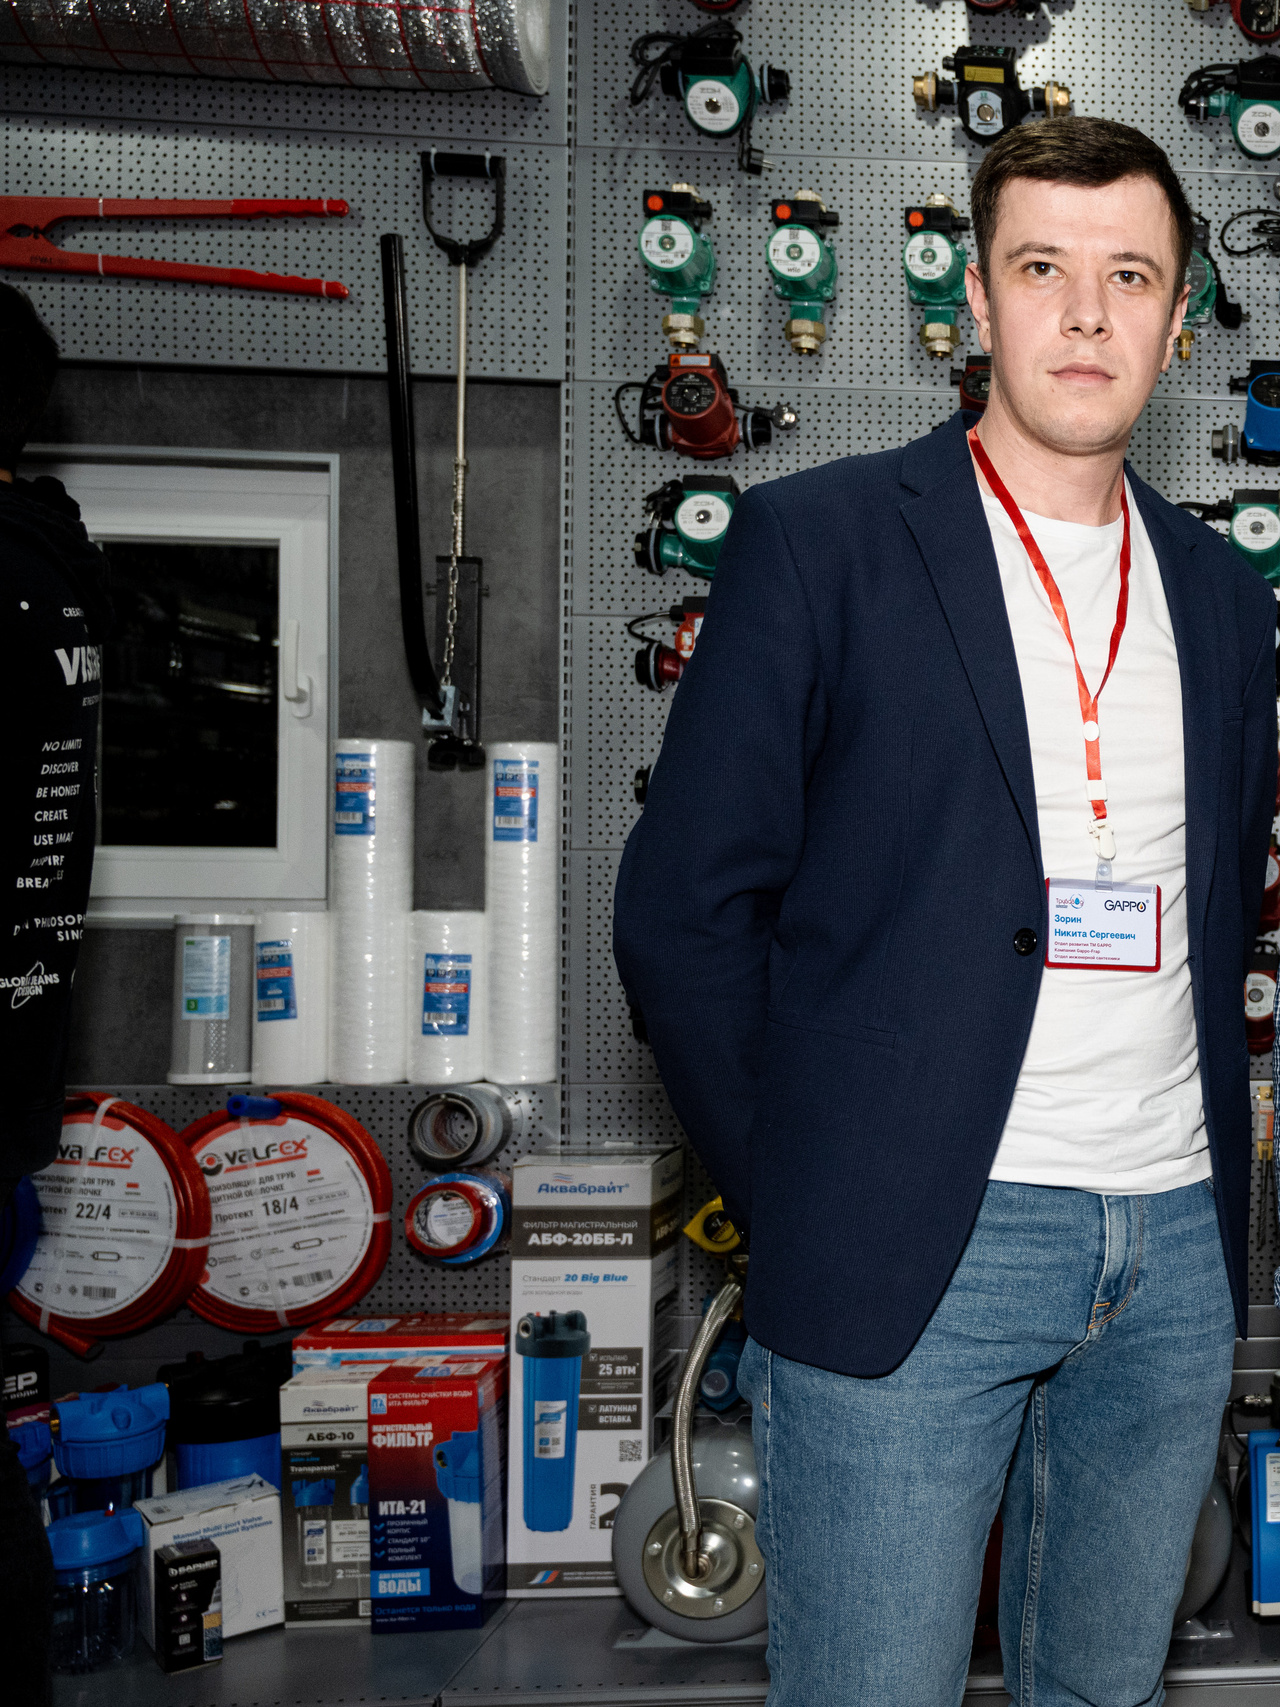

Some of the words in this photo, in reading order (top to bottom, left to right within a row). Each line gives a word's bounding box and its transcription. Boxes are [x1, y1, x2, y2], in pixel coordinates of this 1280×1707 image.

[787, 266, 801, 274] wilo
[41, 741, 60, 752] NO
[61, 738, 83, 751] LIMITS
[40, 761, 79, 775] DISCOVER
[36, 787, 48, 799] BE
[50, 784, 81, 797] HONEST
[34, 809, 69, 822] CREATE
[33, 834, 54, 846] USE
[1104, 899, 1147, 913] GAPPO
[1054, 914, 1082, 924] Зорин
[1054, 928, 1087, 938] Никита
[1089, 929, 1136, 941] Сергеевич
[276, 1170, 297, 1181] ТРУБ
[537, 1181, 625, 1196] Аквабрайт
[211, 1190, 243, 1204] ЩИТНОЙ
[76, 1202, 112, 1221] 22/4
[262, 1196, 300, 1217] 18/4
[215, 1209, 254, 1223] Протект
[523, 1221, 559, 1230] ФИЛЬТР
[560, 1220, 638, 1230] МАГИСТРАЛЬНЫЙ
[528, 1232, 634, 1246] АБФ-20ББ-Л
[522, 1274, 562, 1284] Стандарт
[564, 1273, 578, 1283] 20
[581, 1272, 600, 1284] Big
[602, 1273, 629, 1282] Blue
[598, 1363, 613, 1376] 25
[421, 1391, 453, 1399] ОЧИСТКИ
[453, 1390, 473, 1398] ВОДЫ
[303, 1404, 355, 1414] Аквабрайт
[402, 1399, 430, 1407] ФИЛЬТР
[598, 1404, 638, 1414] ЛАТУННАЯ
[598, 1414, 632, 1424] ВСТАВКА
[372, 1422, 433, 1432] МАГИСТРАЛЬНЫЙ
[306, 1431, 355, 1442] АБФ-10
[372, 1431, 434, 1448] ФИЛЬТР
[290, 1464, 336, 1473] Transparent
[378, 1499, 427, 1516] ИТА-21
[589, 1483, 597, 1530] ГАРАНТИЯ
[387, 1527, 411, 1535] КОРПУС
[388, 1536, 419, 1545] СТАНДАРТ
[387, 1546, 416, 1554] ПОЛНЫЙ
[387, 1554, 422, 1562] КОМПЛЕКТ
[336, 1568, 344, 1580] 2
[378, 1578, 422, 1595] ВОДЫ
[374, 1606, 421, 1616] Останется
[422, 1604, 453, 1613] только
[454, 1603, 477, 1613] вода
